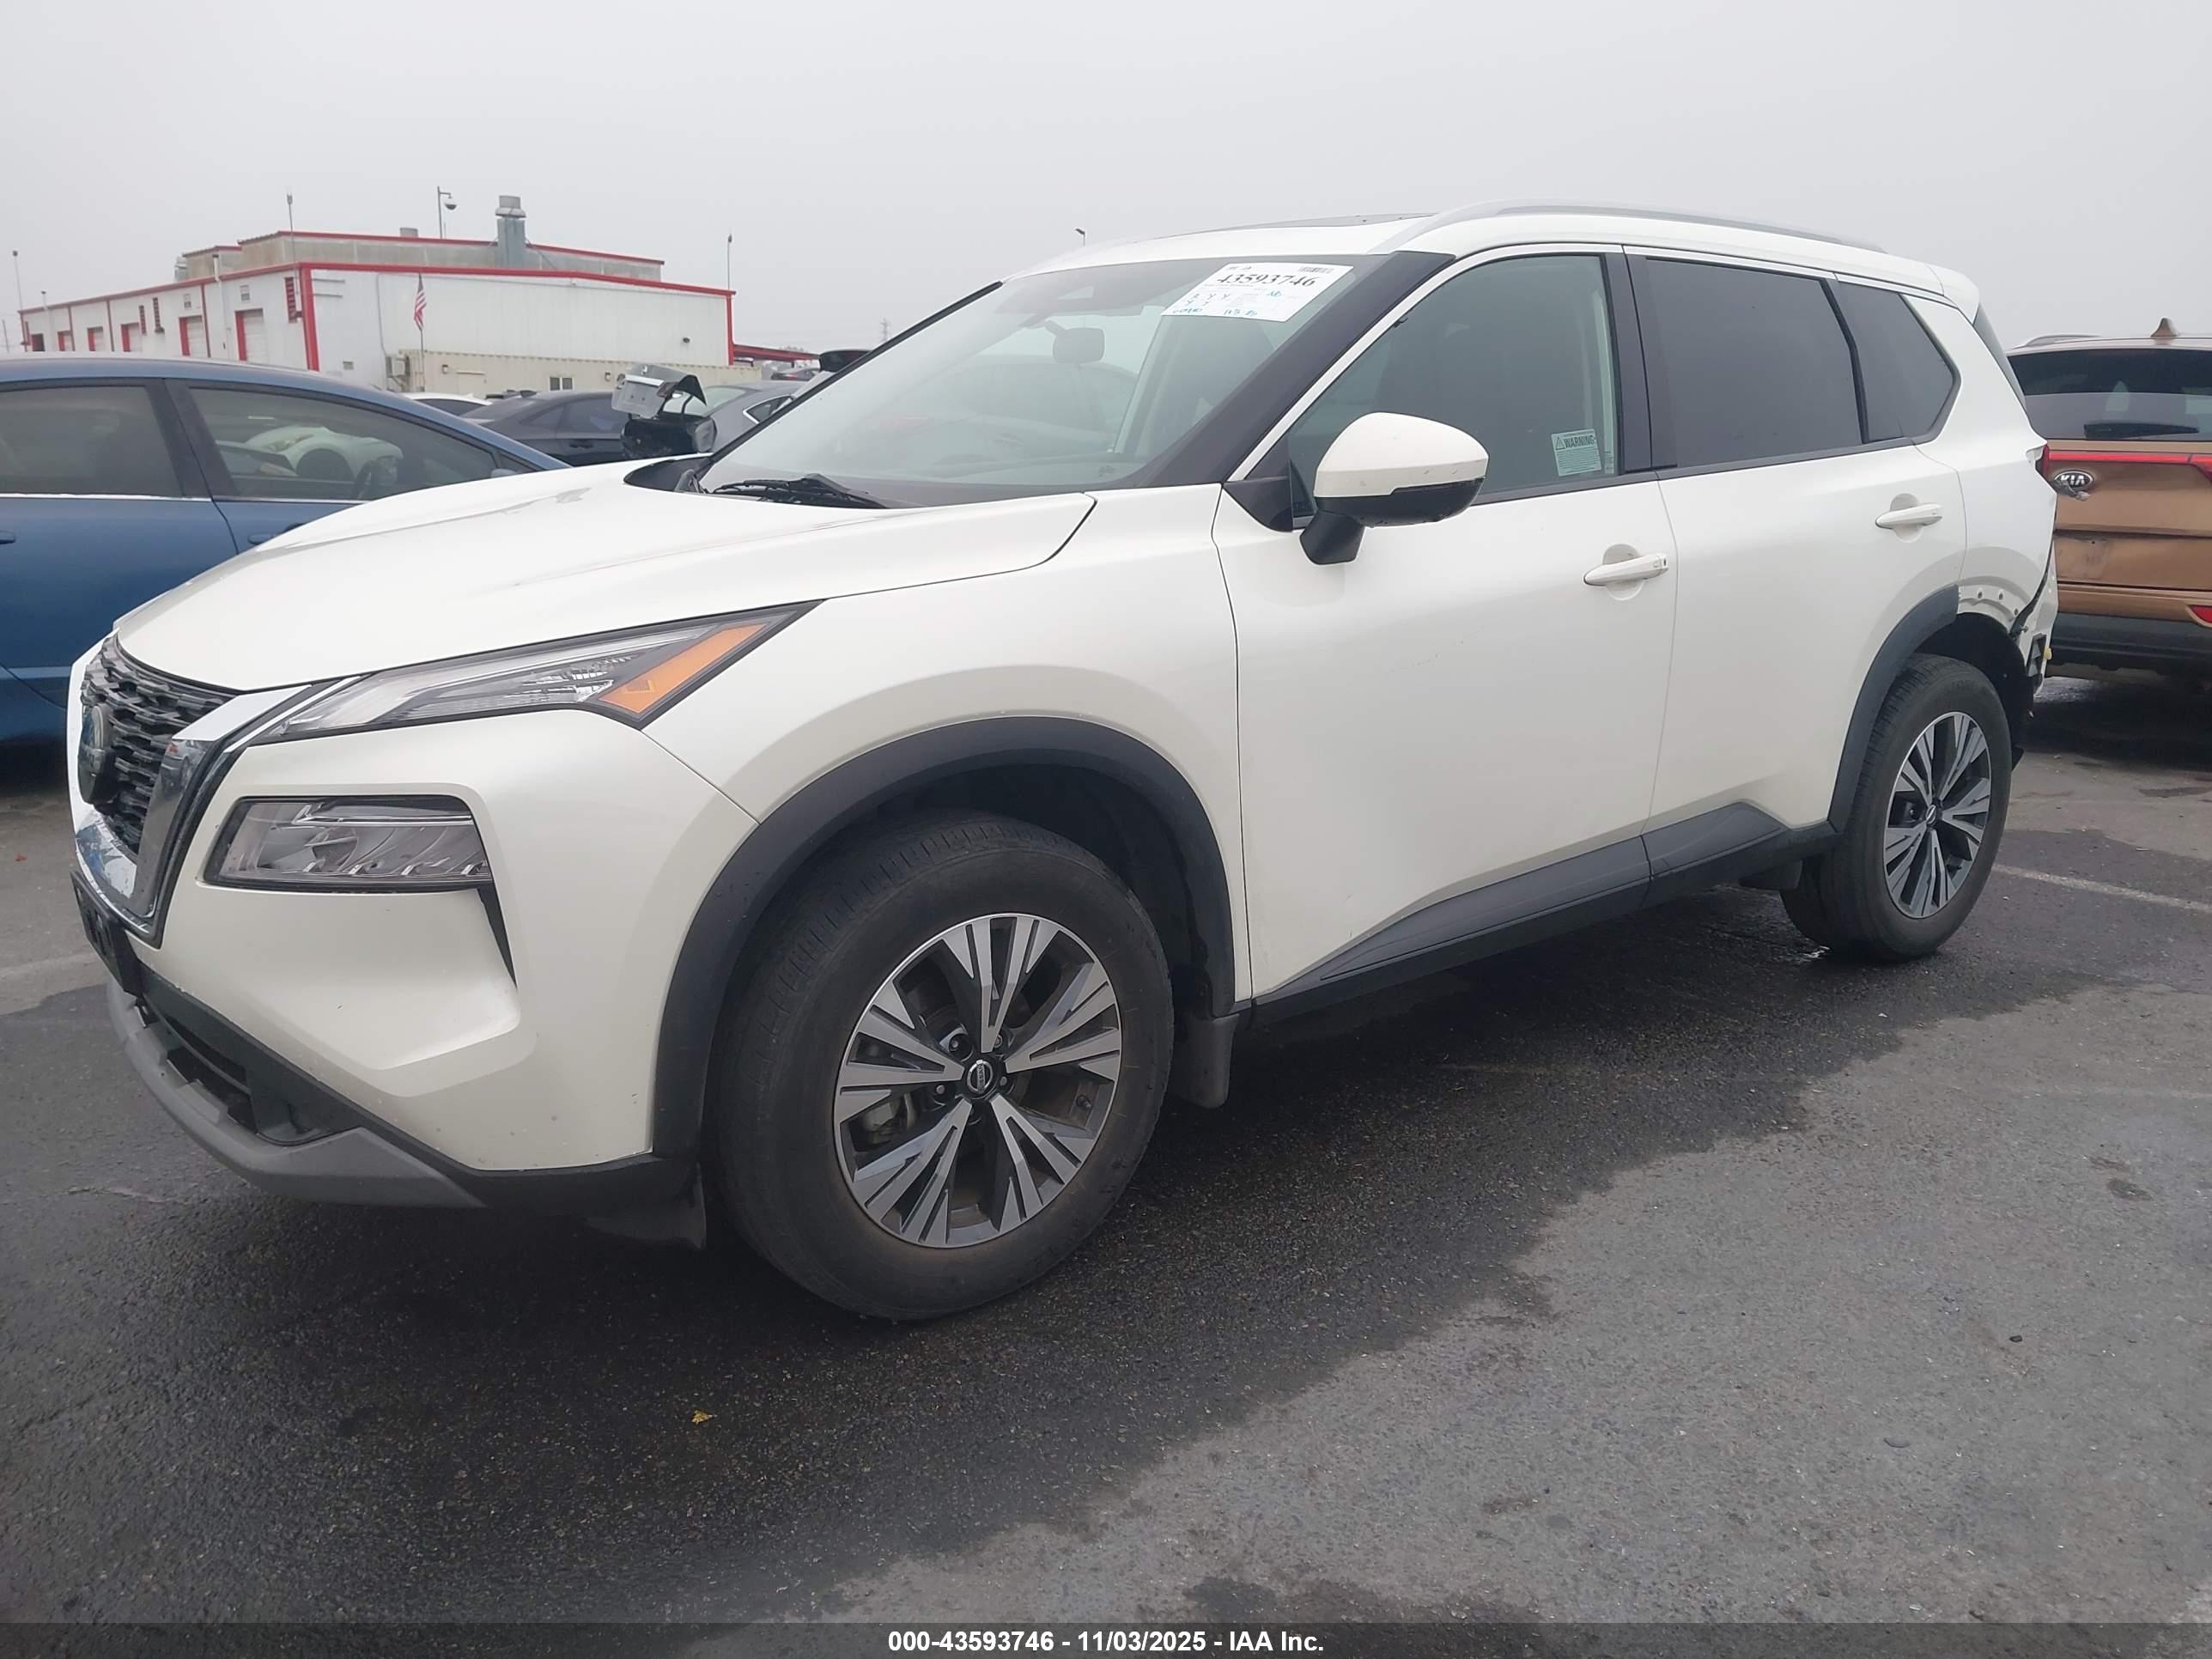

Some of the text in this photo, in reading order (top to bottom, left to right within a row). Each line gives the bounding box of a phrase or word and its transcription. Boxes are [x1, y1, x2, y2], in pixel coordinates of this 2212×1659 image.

[1217, 274, 1320, 287] 43593746
[1565, 434, 1595, 448] WARNING
[2061, 475, 2085, 486] KIA
